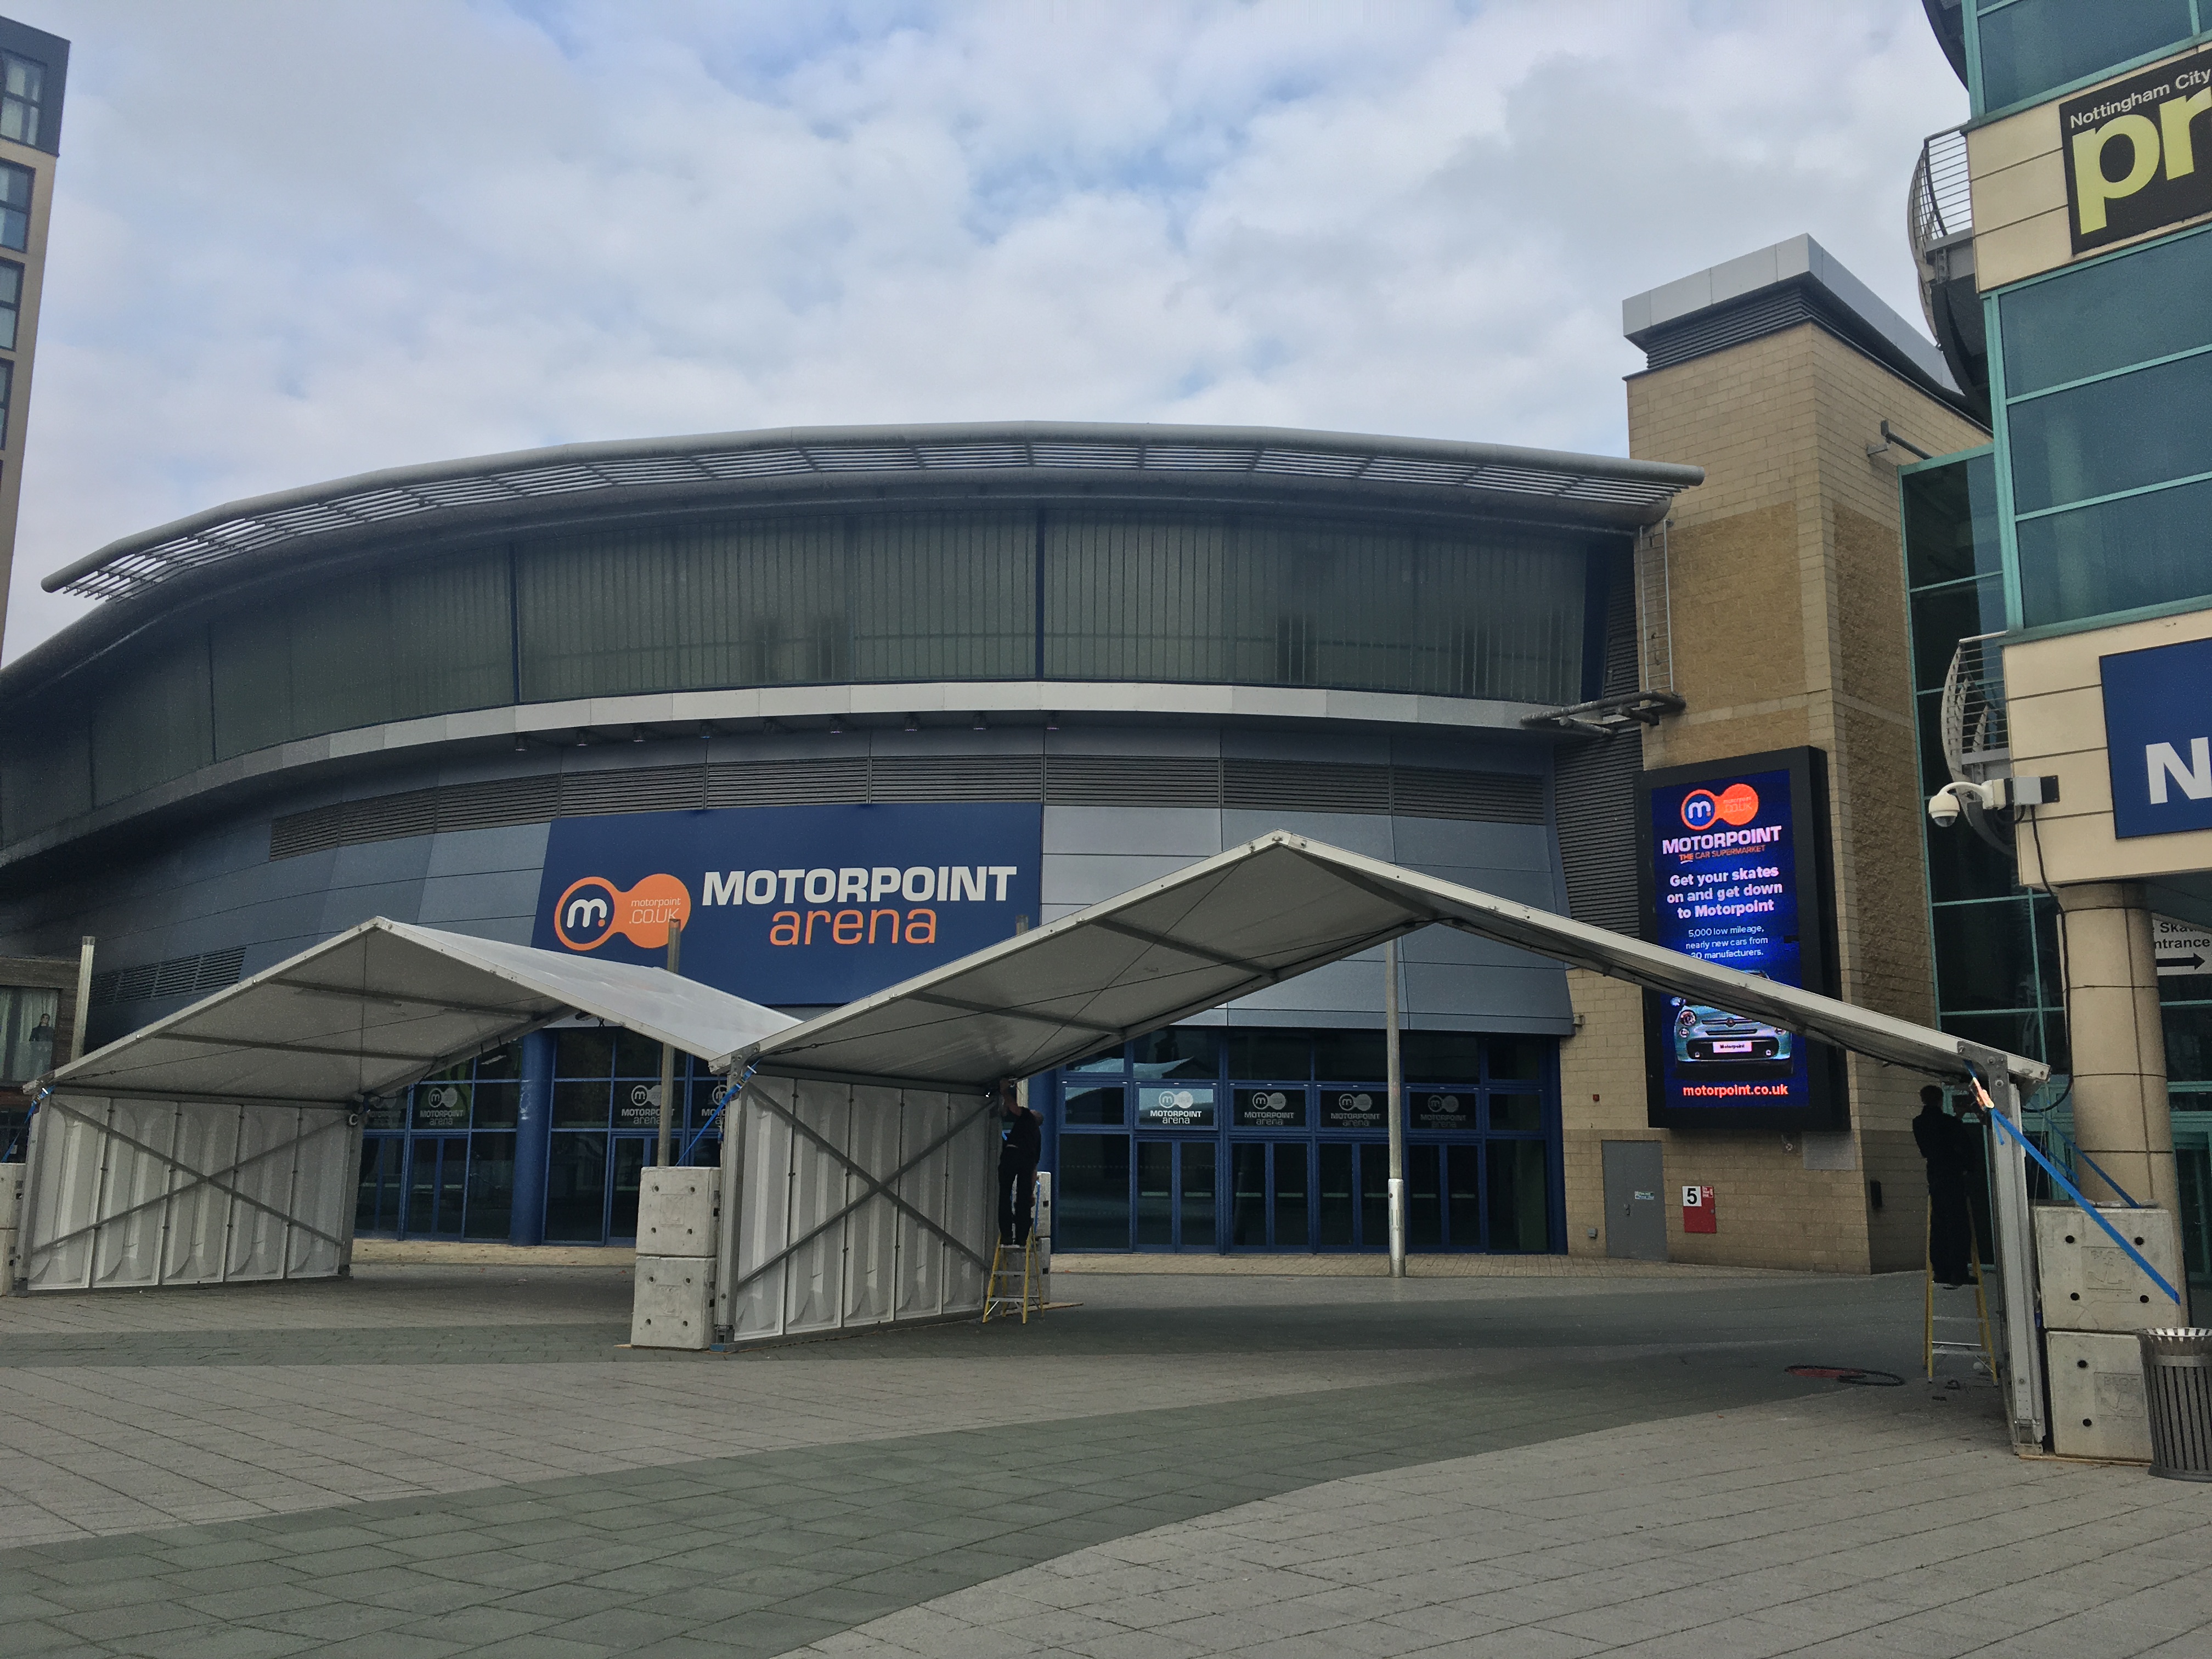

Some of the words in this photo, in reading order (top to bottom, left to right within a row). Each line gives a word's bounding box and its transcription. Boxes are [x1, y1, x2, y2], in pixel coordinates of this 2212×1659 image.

[2070, 84, 2170, 128] Nottingham
[2175, 69, 2212, 91] City
[1662, 825, 1782, 854] MOTORPOINT
[1679, 853, 1694, 861] THE
[1695, 850, 1710, 859] CAR
[1711, 844, 1765, 857] SUPERMARKET
[1669, 874, 1694, 887] Get
[1697, 872, 1729, 887] your
[1731, 866, 1780, 881] skates
[702, 866, 1017, 906] MOTORPOINT
[1667, 894, 1684, 904] on
[1687, 888, 1713, 902] and
[1717, 885, 1740, 901] get
[1743, 883, 1783, 896] down
[631, 897, 681, 908] motorpoint
[1677, 907, 1691, 919] to
[1694, 899, 1774, 917] Motorpoint
[769, 909, 936, 946] arena
[1688, 928, 1712, 938] 5,000
[1713, 927, 1728, 935] low
[1730, 926, 1764, 934] mileage,
[1685, 940, 1710, 950] nearly
[1749, 936, 1768, 945] from
[2155, 939, 2210, 949] ntrance
[1705, 949, 1764, 959] manufacturers.
[1683, 1084, 1788, 1098] motorpoint.co.uk
[429, 1118, 453, 1126] arena
[1687, 1188, 1697, 1205] 5
